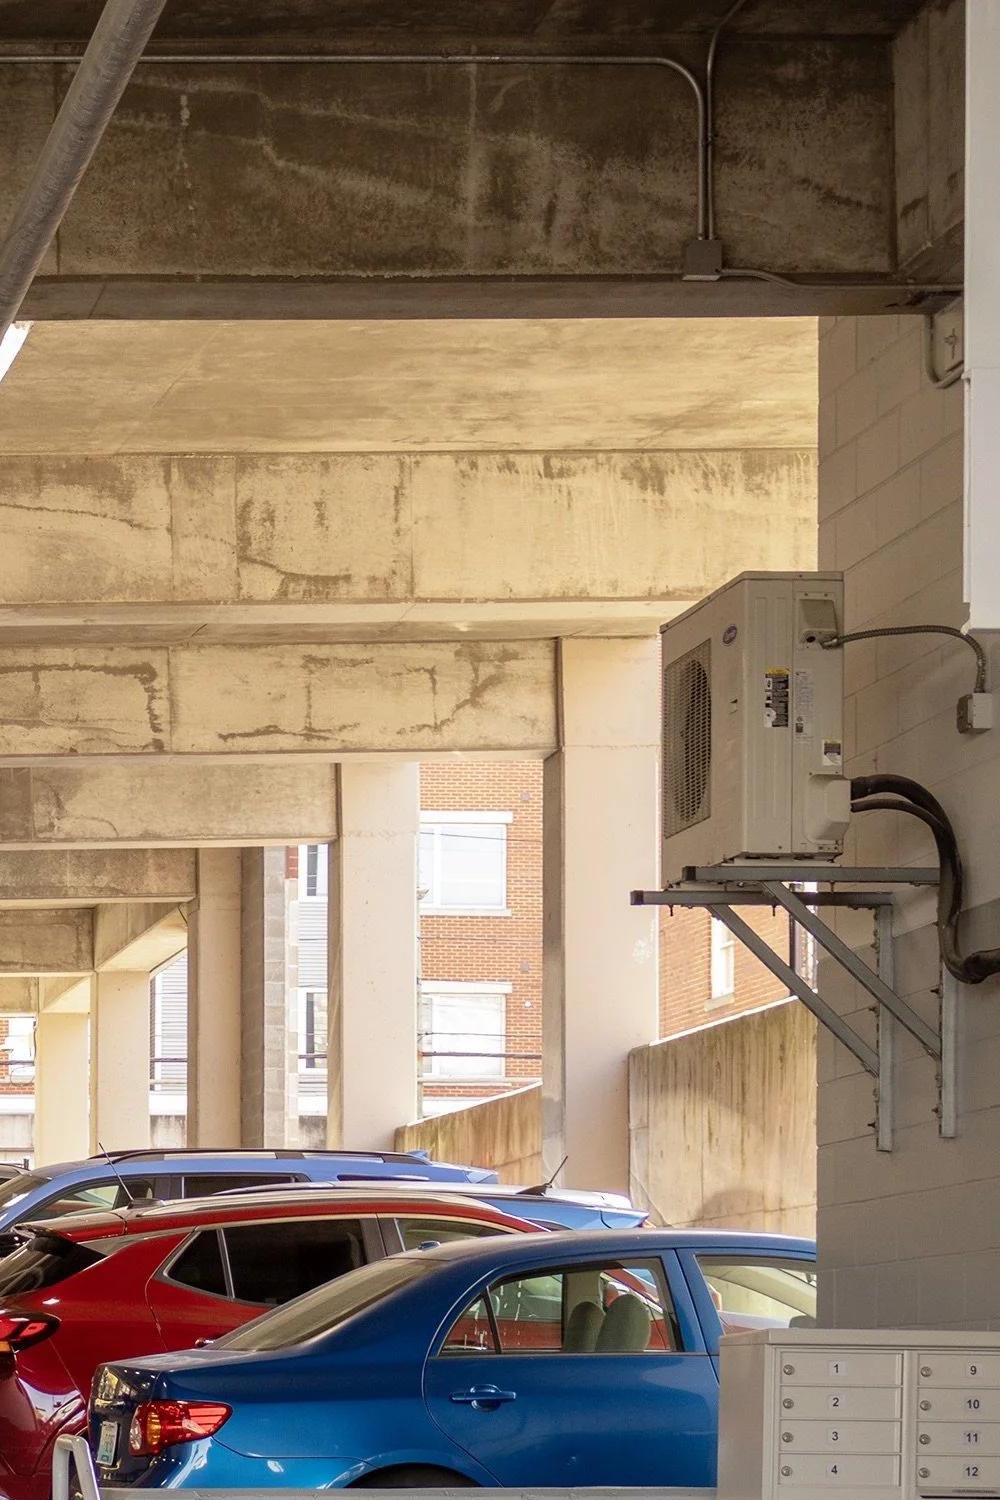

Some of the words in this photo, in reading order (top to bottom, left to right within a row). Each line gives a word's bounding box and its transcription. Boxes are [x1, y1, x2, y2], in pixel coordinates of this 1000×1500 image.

[832, 1397, 839, 1407] 2
[967, 1400, 980, 1409] 10
[832, 1431, 839, 1441] 3
[966, 1433, 978, 1442] 11
[831, 1465, 838, 1474] 4
[966, 1467, 979, 1476] 12
